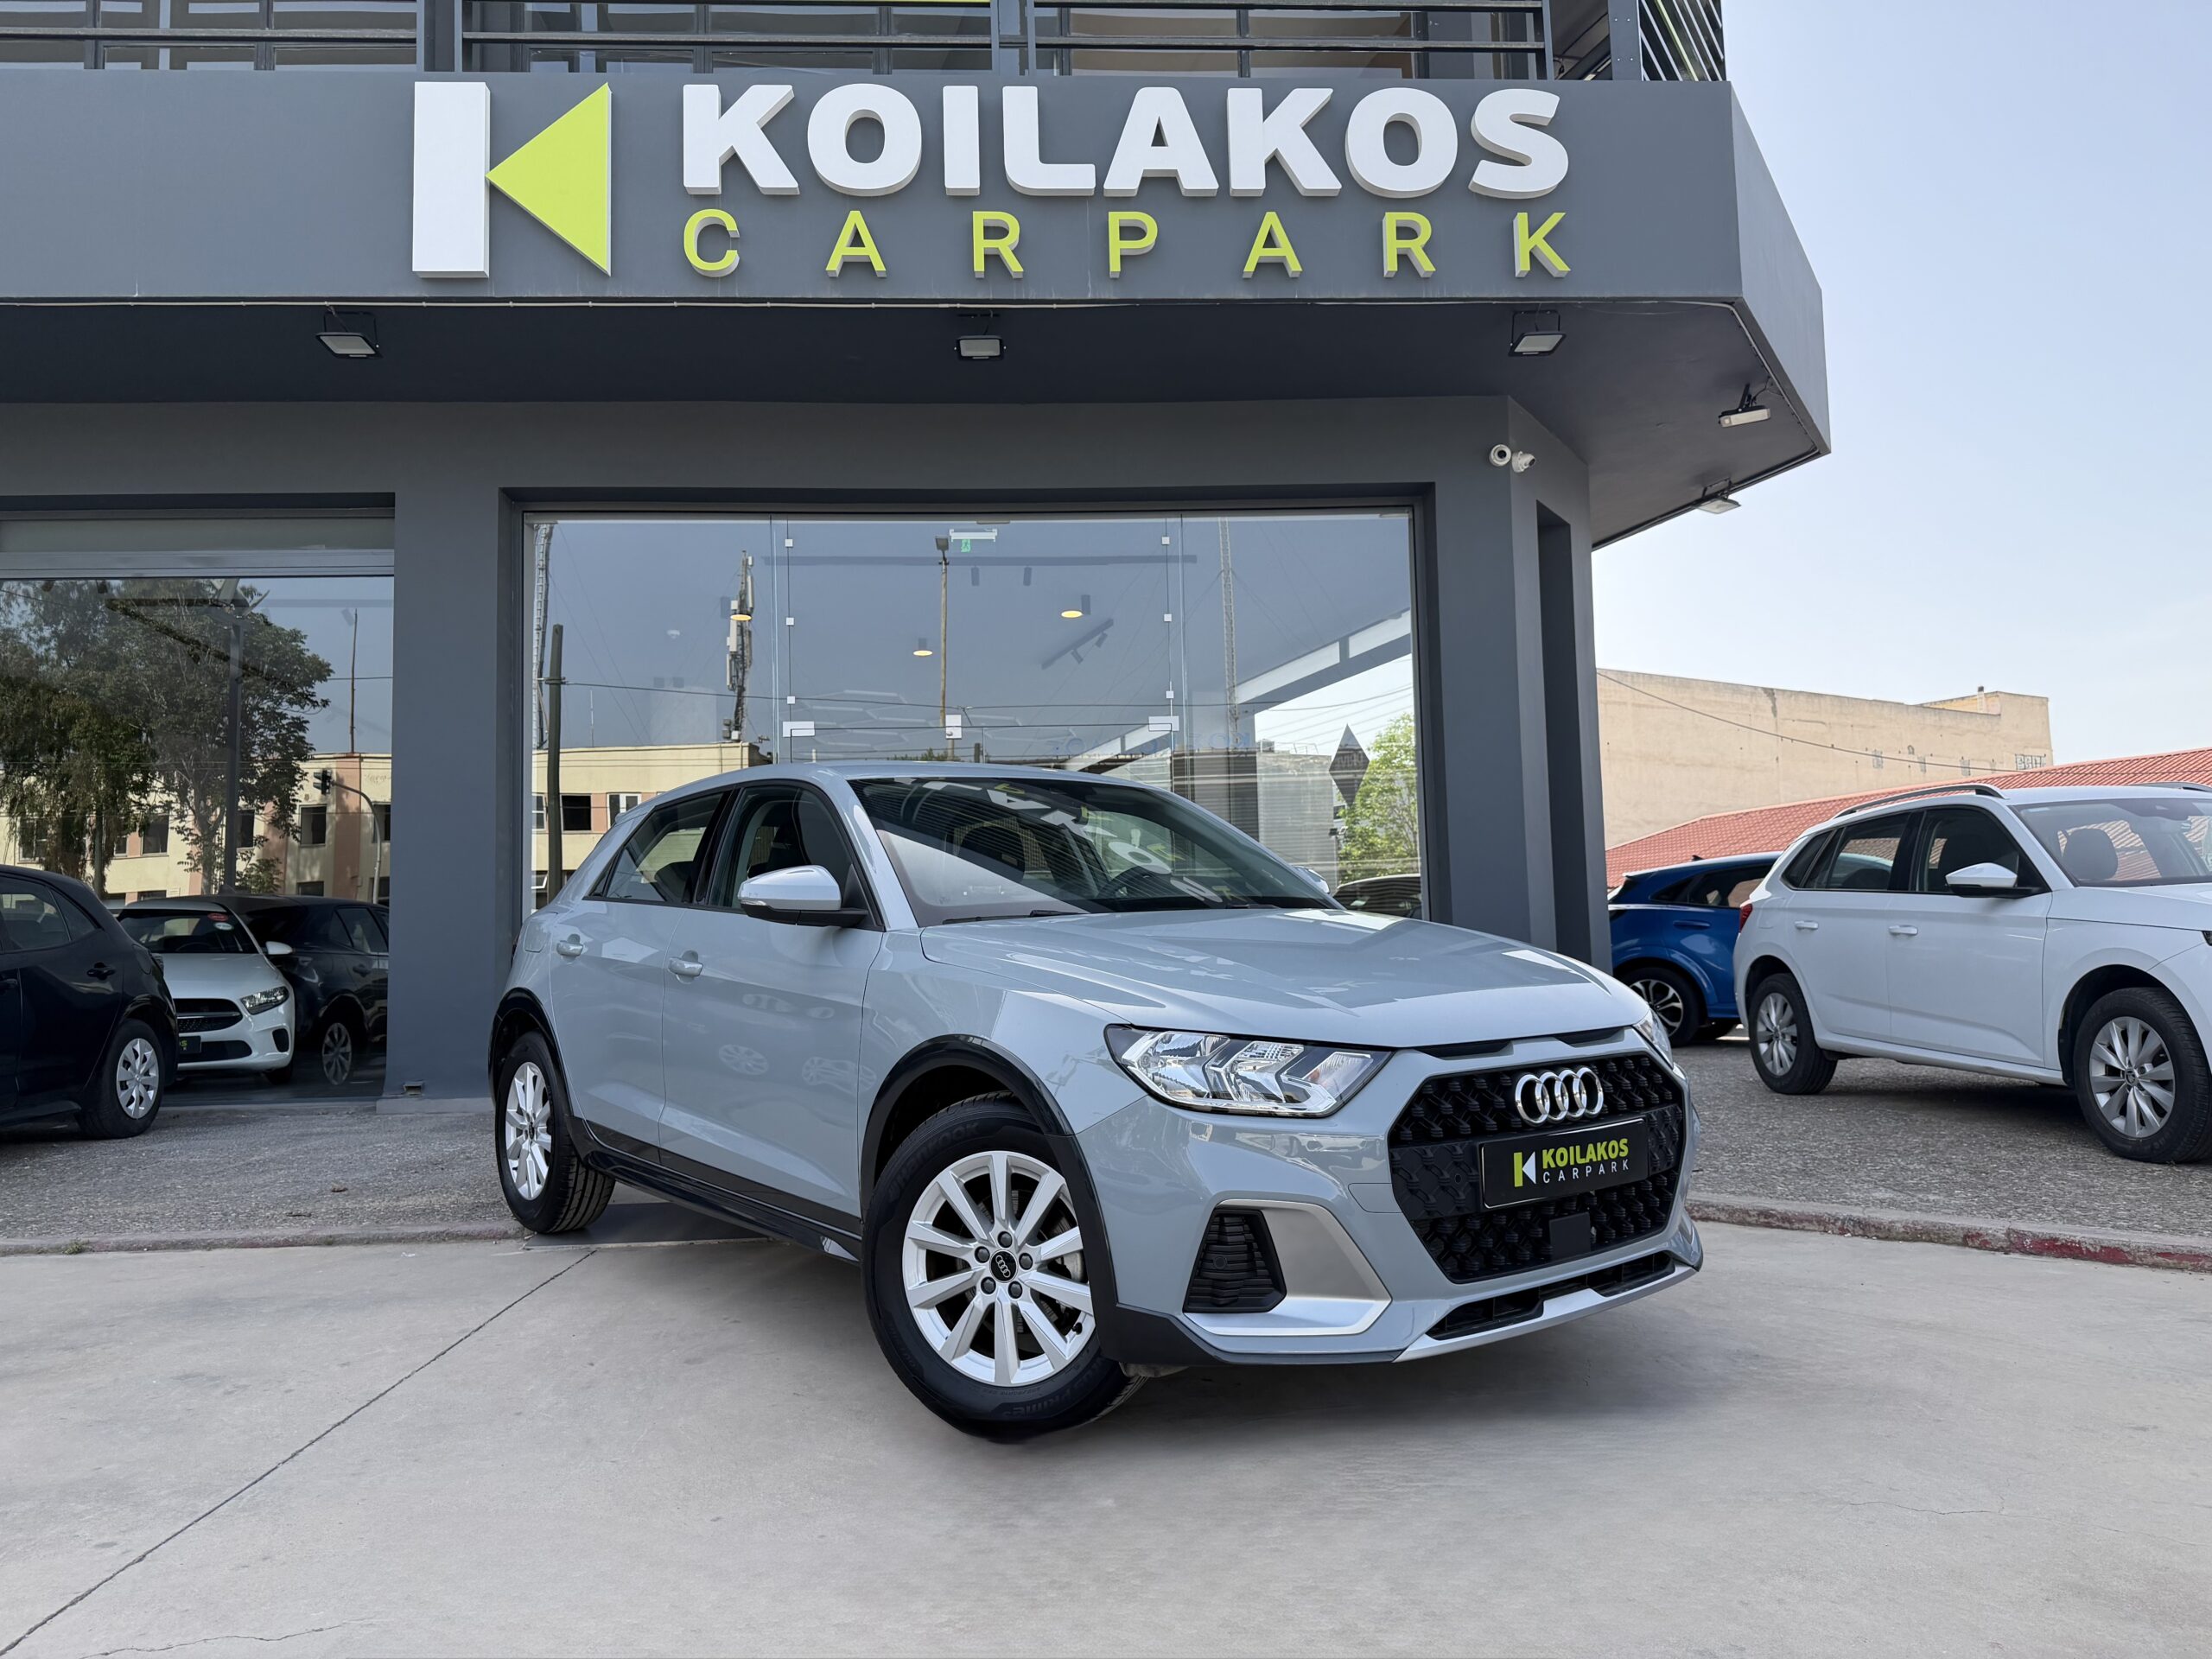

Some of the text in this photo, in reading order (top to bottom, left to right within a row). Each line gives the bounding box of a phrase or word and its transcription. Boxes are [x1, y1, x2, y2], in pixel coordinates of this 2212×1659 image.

[683, 83, 1569, 198] KOILAKOS
[683, 209, 1571, 279] CARPARK
[1542, 1138, 1629, 1169] KOILAKOS
[1542, 1159, 1629, 1184] CARPARK
